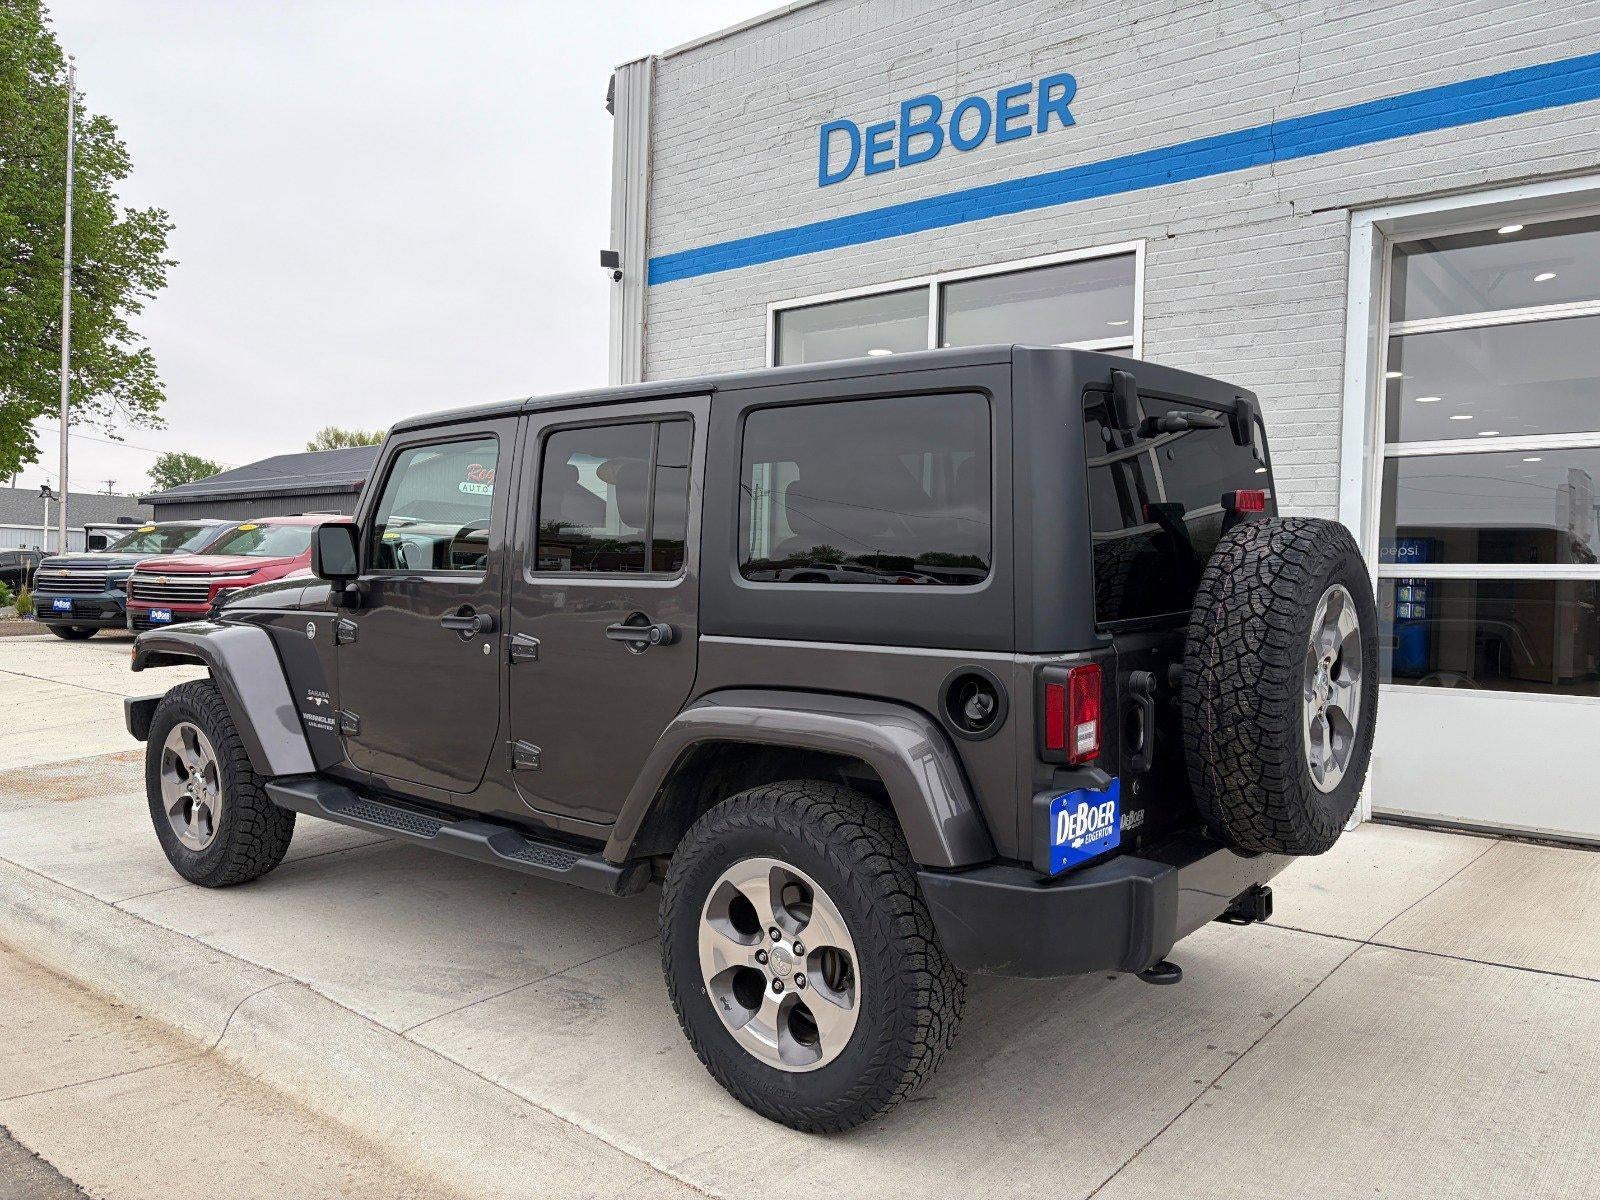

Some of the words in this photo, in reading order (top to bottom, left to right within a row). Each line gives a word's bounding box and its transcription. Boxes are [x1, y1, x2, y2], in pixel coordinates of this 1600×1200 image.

[462, 483, 489, 493] AUTO
[1380, 545, 1419, 558] pepsi
[307, 689, 330, 699] SAHARA
[302, 712, 336, 725] WRANGLER
[1084, 825, 1114, 845] EDGERTON
